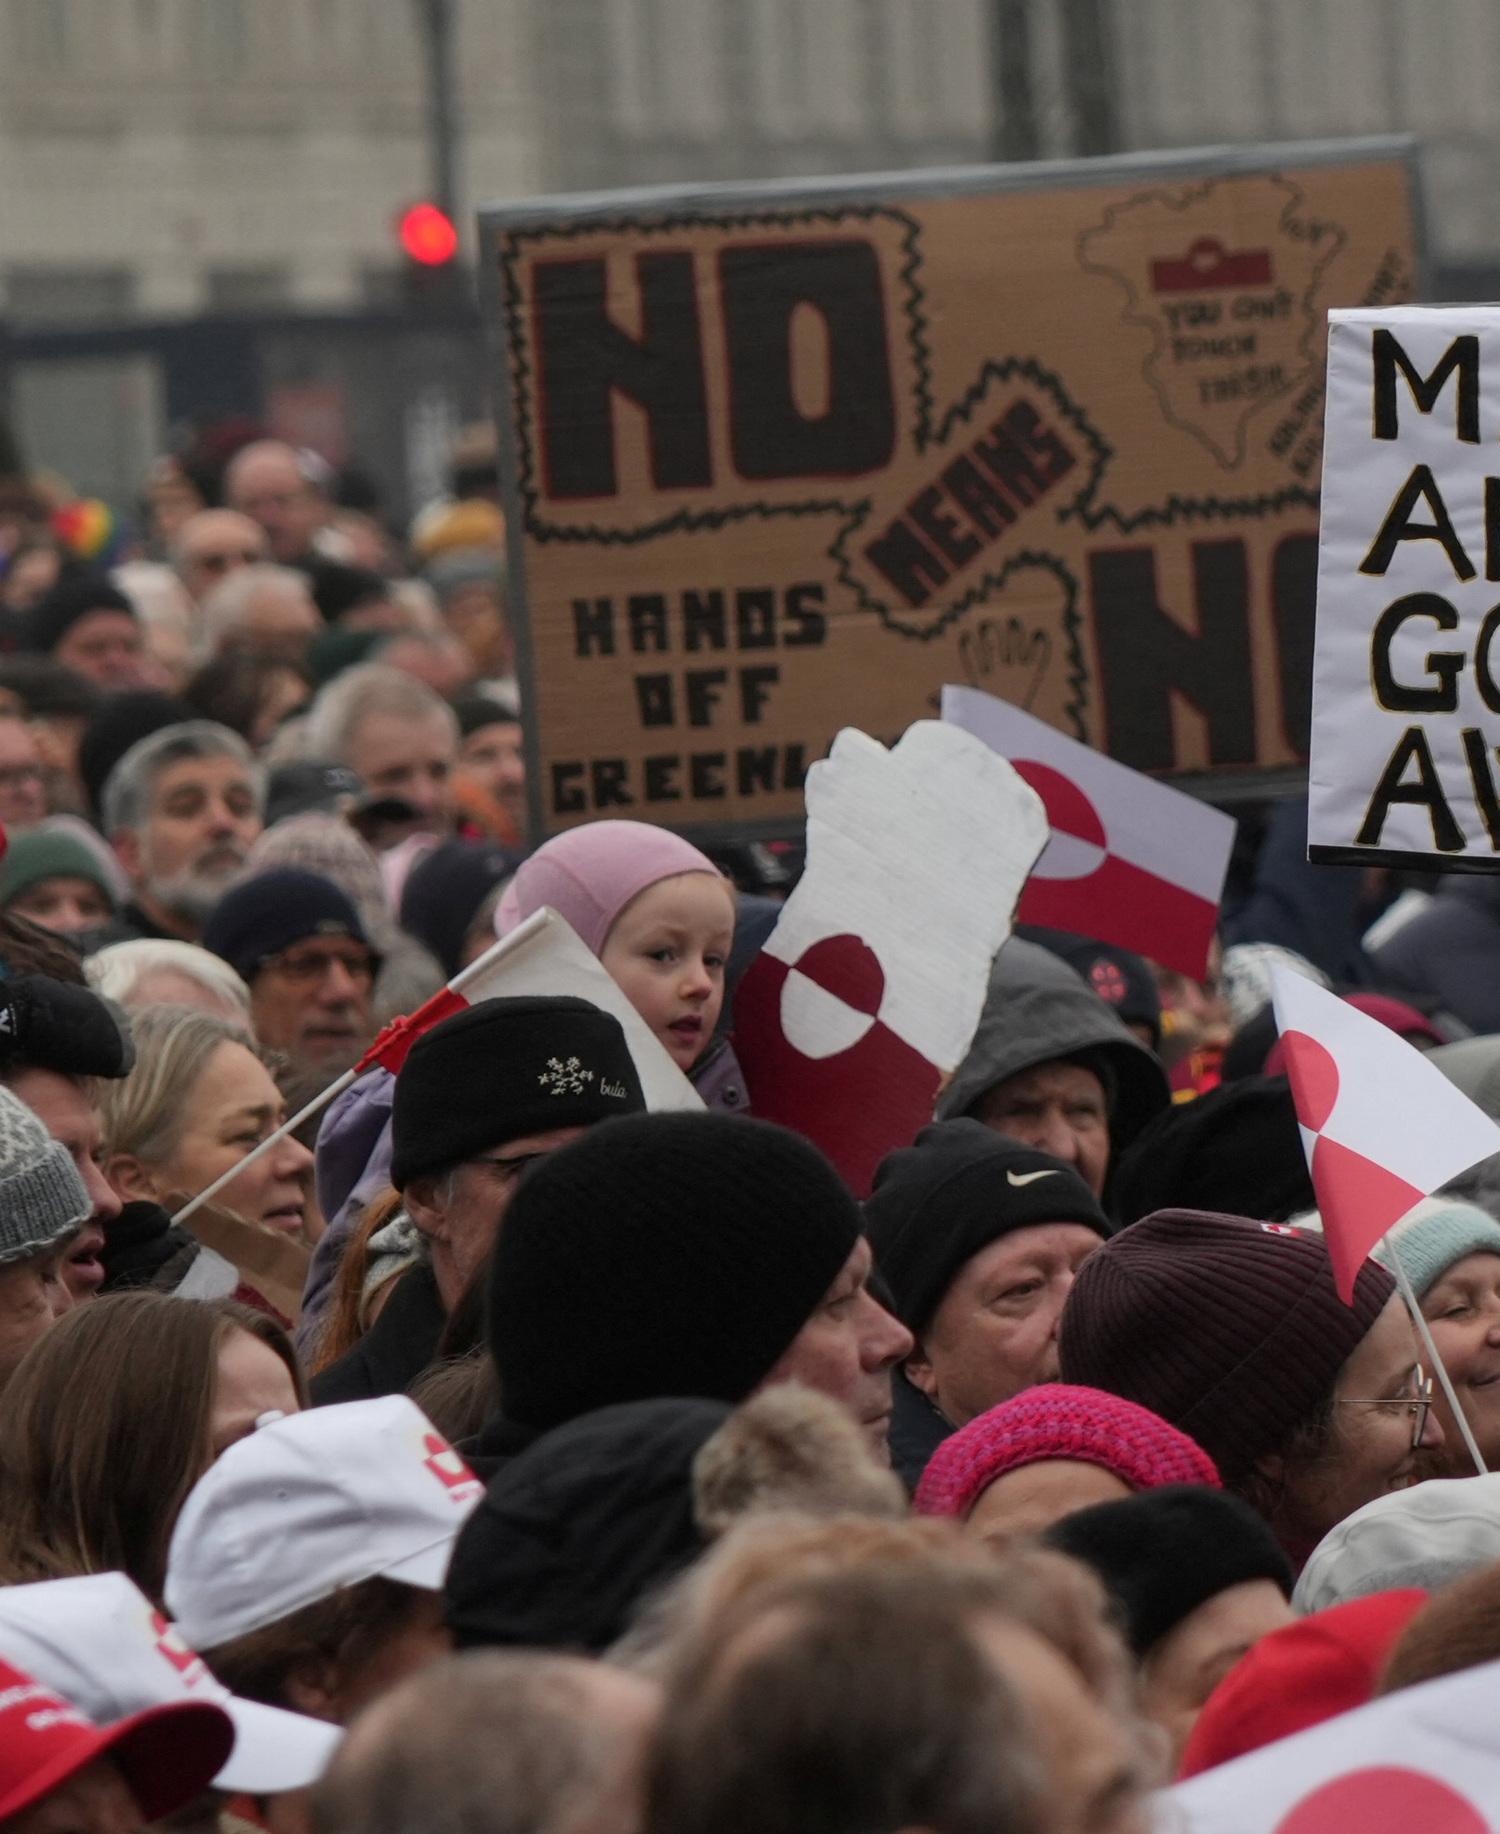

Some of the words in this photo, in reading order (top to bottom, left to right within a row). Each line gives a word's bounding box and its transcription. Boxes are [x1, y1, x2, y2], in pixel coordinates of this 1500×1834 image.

[528, 238, 898, 502] NO
[863, 399, 1077, 607] MEANS
[571, 582, 827, 657] HANDS
[1086, 531, 1320, 771] N
[634, 665, 780, 728] OFF
[600, 1077, 627, 1099] bula
